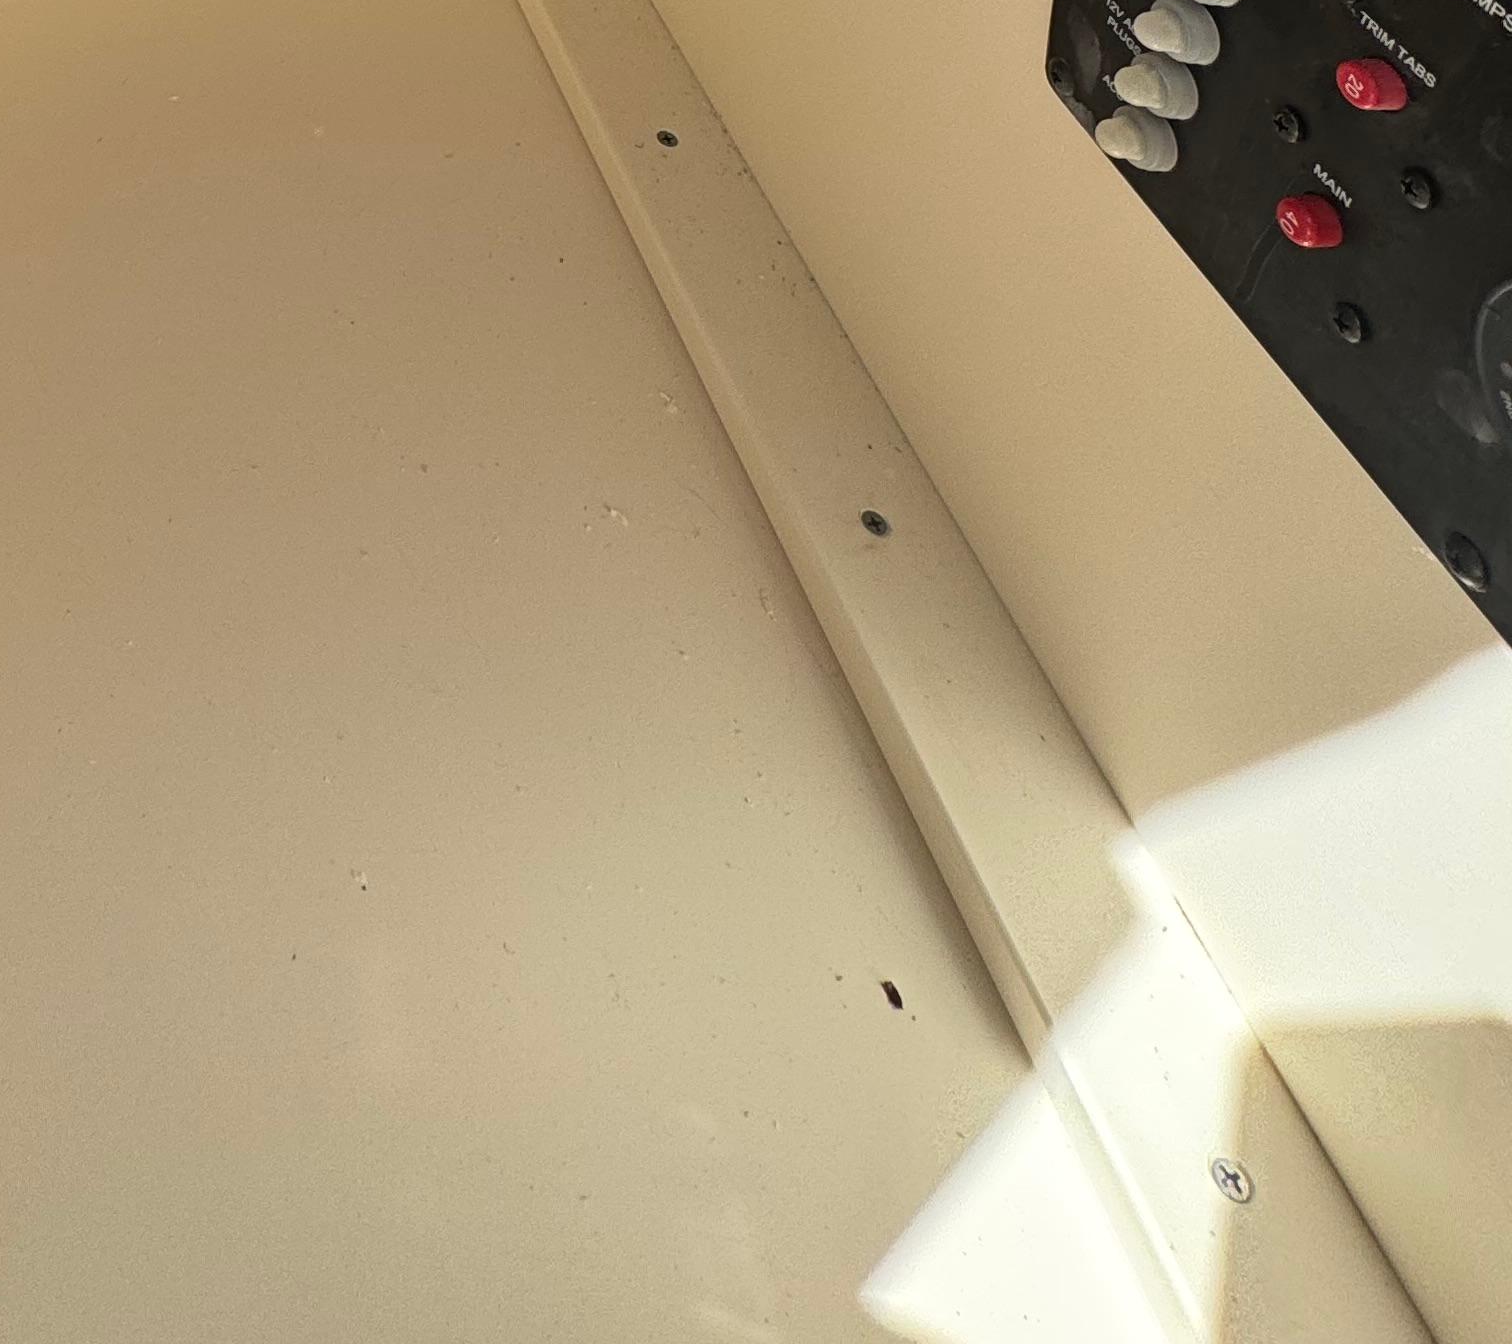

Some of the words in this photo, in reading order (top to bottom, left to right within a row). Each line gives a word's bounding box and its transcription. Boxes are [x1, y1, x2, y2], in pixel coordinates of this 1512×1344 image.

[1359, 10, 1396, 51] TRIM
[1396, 44, 1437, 89] TABS
[1344, 73, 1364, 100] 20
[1313, 163, 1353, 208] MAIN
[1279, 211, 1300, 236] 40
